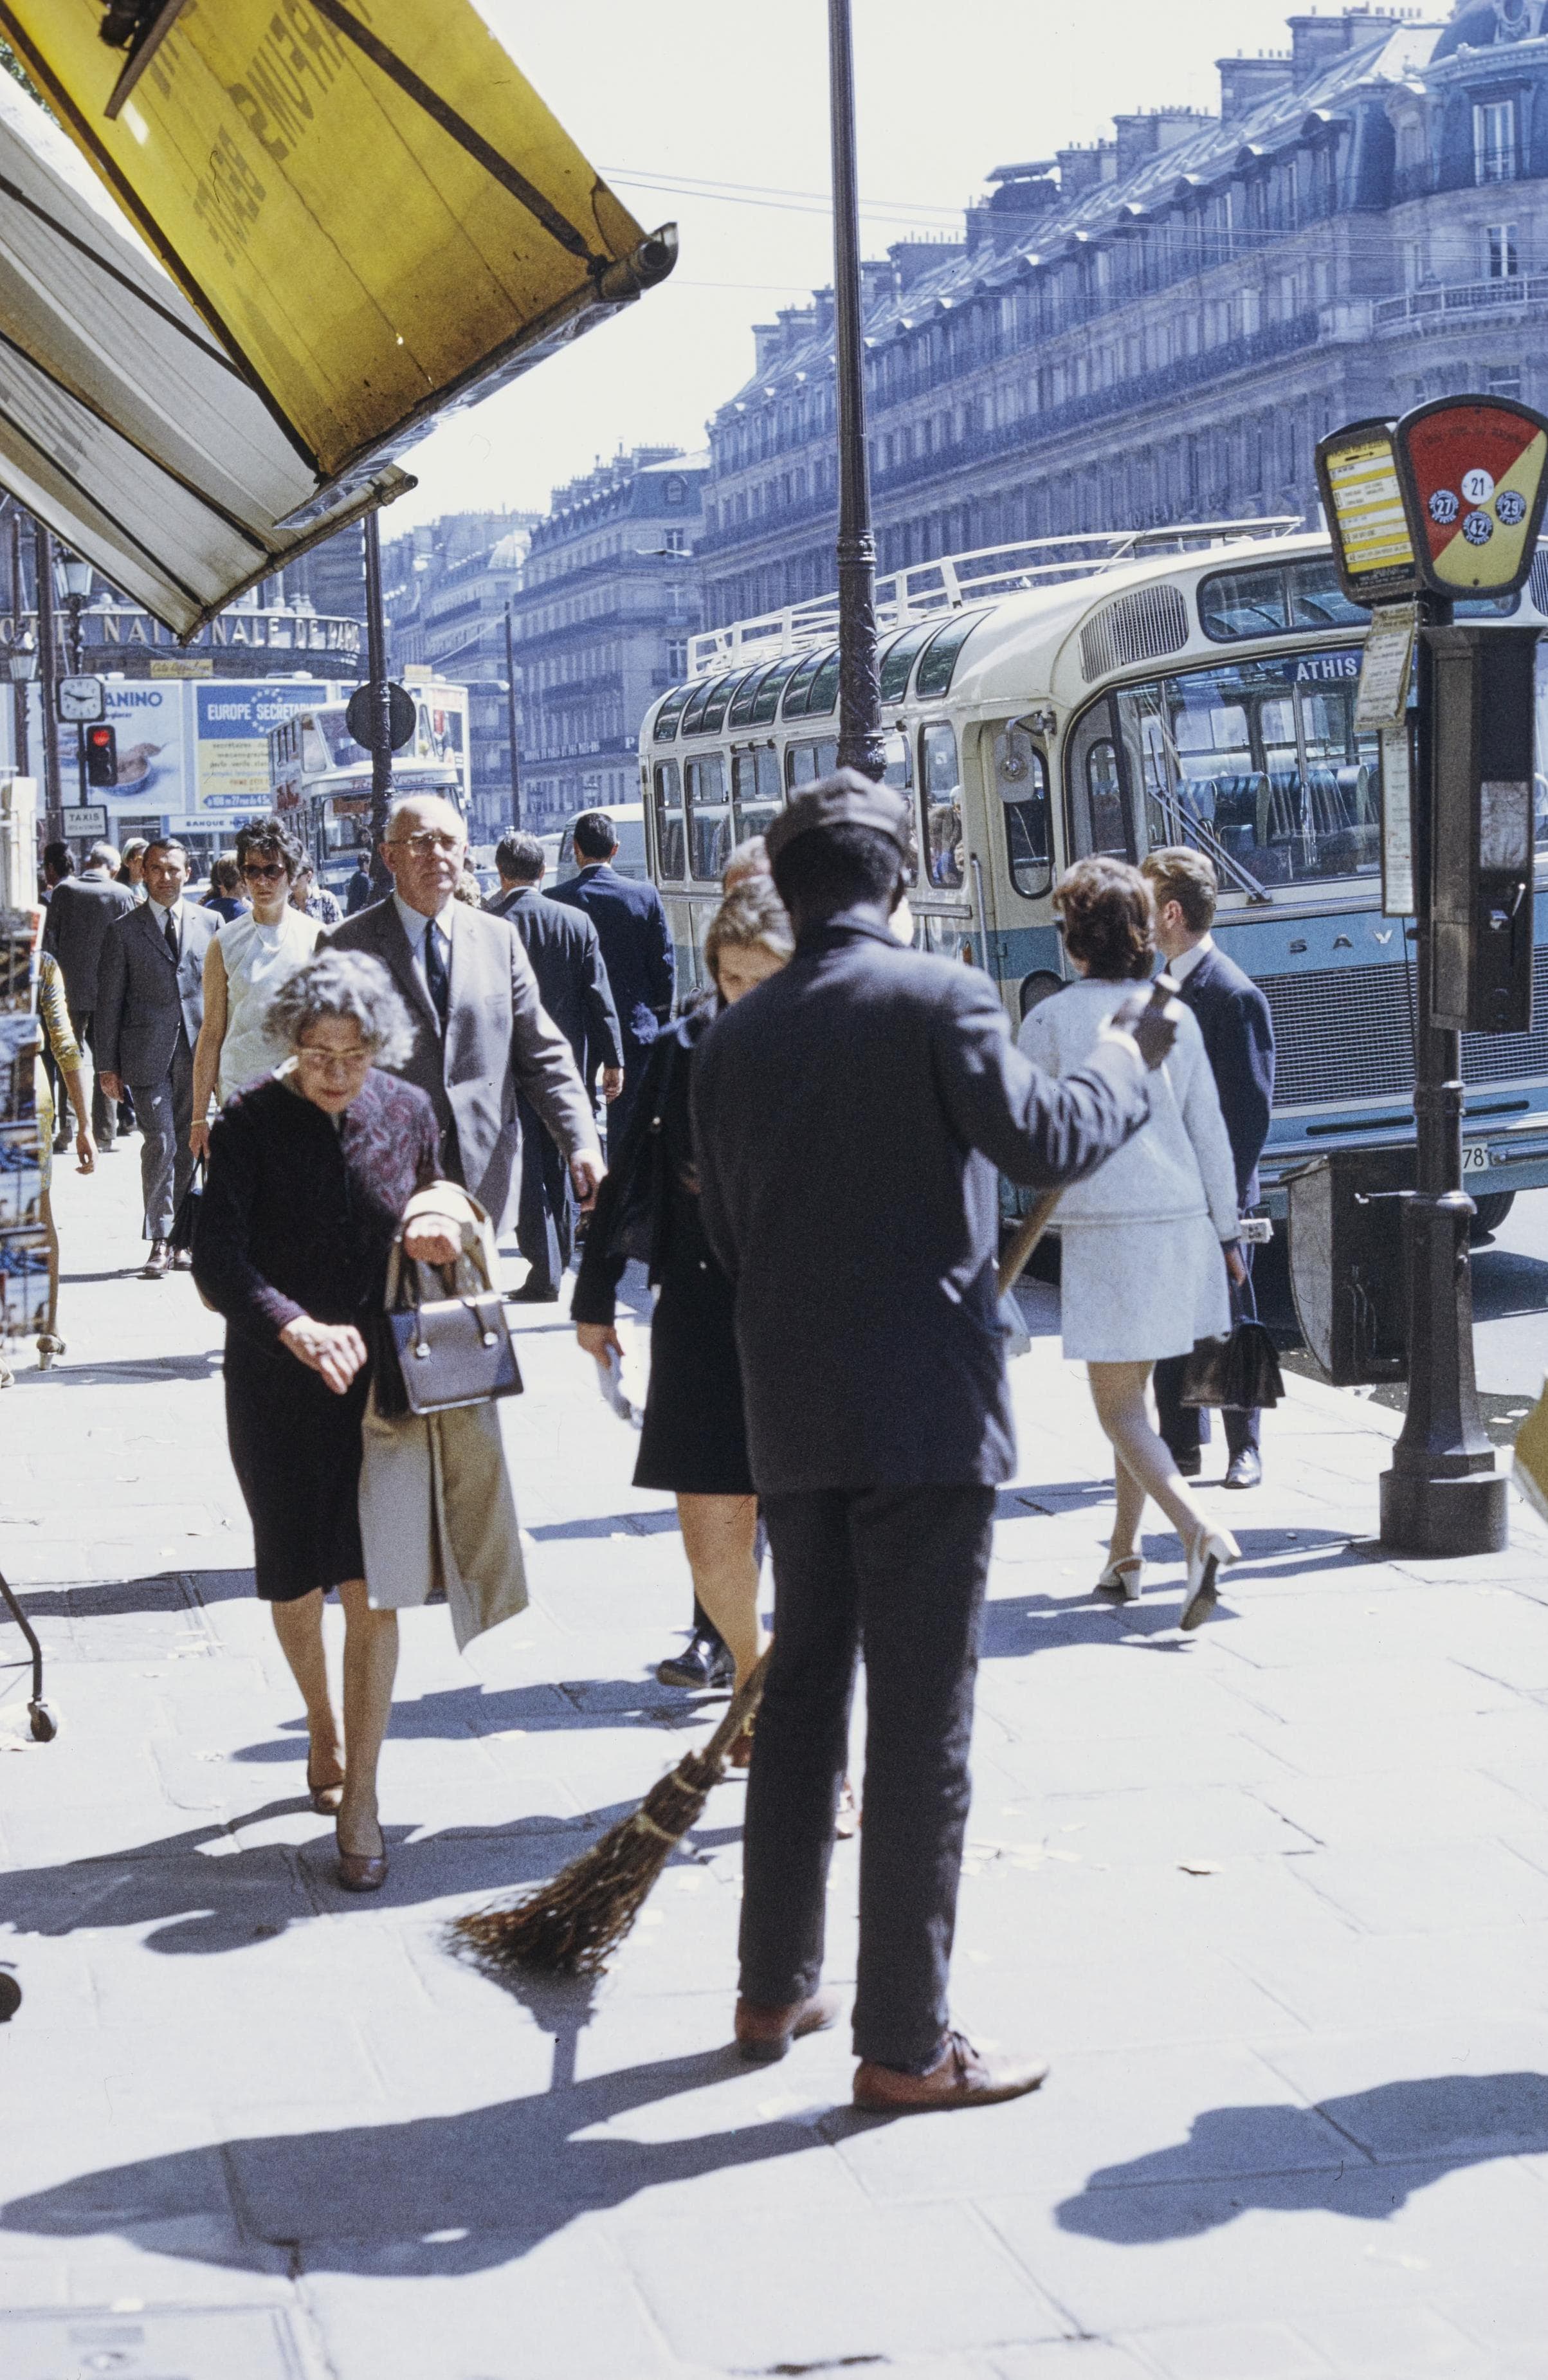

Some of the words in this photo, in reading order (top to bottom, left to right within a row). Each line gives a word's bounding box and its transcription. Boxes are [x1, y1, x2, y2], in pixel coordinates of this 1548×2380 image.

[1471, 477, 1484, 496] 21
[1437, 499, 1452, 515] 27
[1504, 500, 1519, 515] 29
[1470, 520, 1487, 535] 42
[104, 614, 280, 645] NATNALE
[1297, 657, 1358, 681] ATHIS
[105, 691, 163, 707] ANINO
[207, 704, 251, 720] EUROPE
[69, 813, 100, 821] TAXIS
[1289, 929, 1393, 954] SAV
[1462, 1148, 1484, 1169] 78
